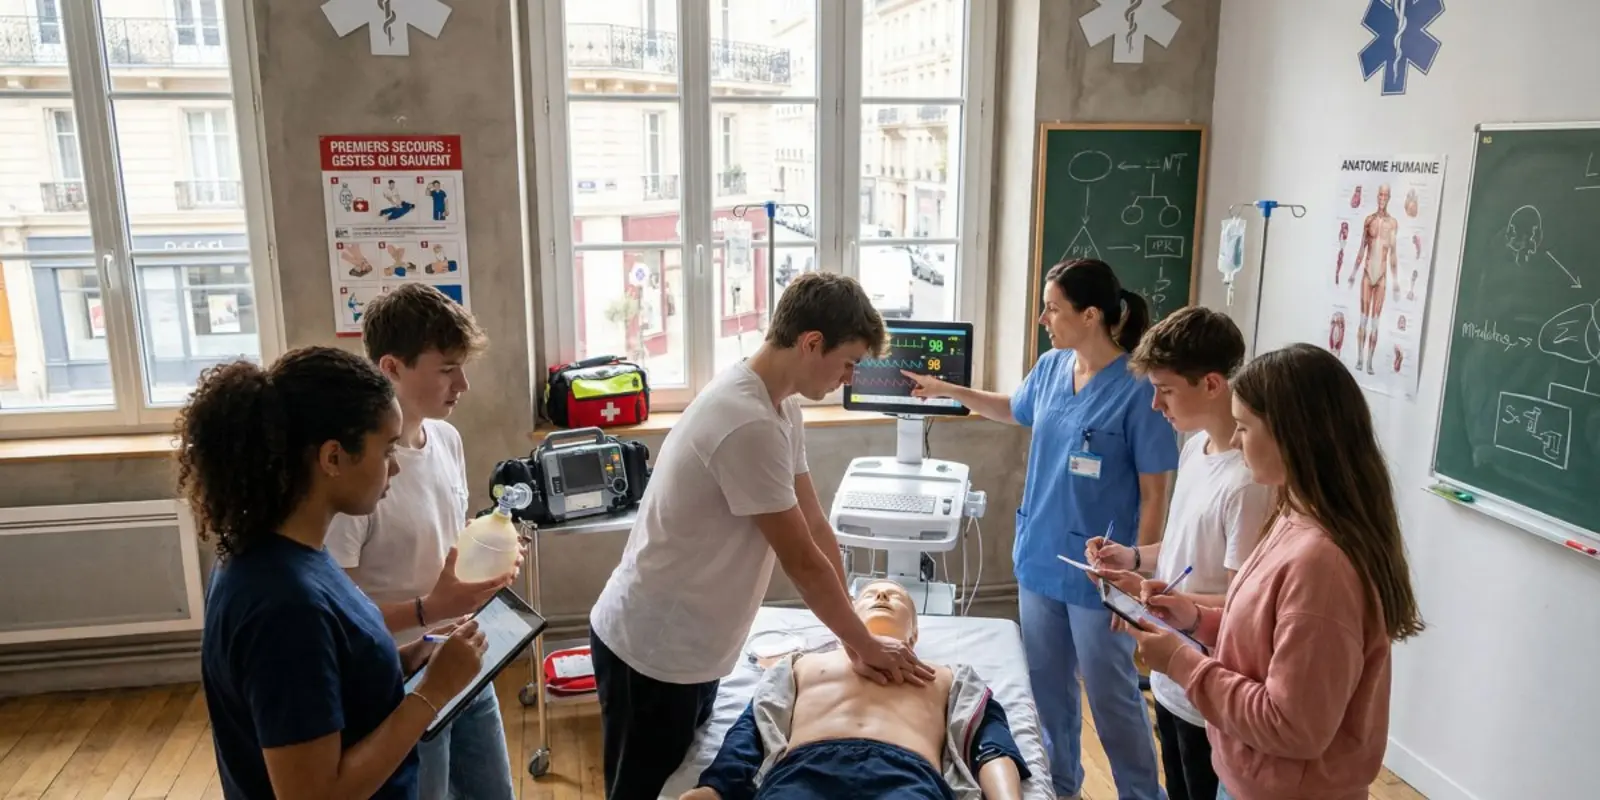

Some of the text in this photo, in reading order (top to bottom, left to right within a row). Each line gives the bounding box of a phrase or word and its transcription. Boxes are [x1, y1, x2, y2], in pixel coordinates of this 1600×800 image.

[330, 140, 452, 153] PREMIERS SECOURS :
[332, 154, 452, 167] GESTES QUI SAUVENT
[1341, 159, 1440, 174] ANATOMIE HUMAINE
[929, 340, 943, 353] 98
[928, 359, 941, 370] 98
